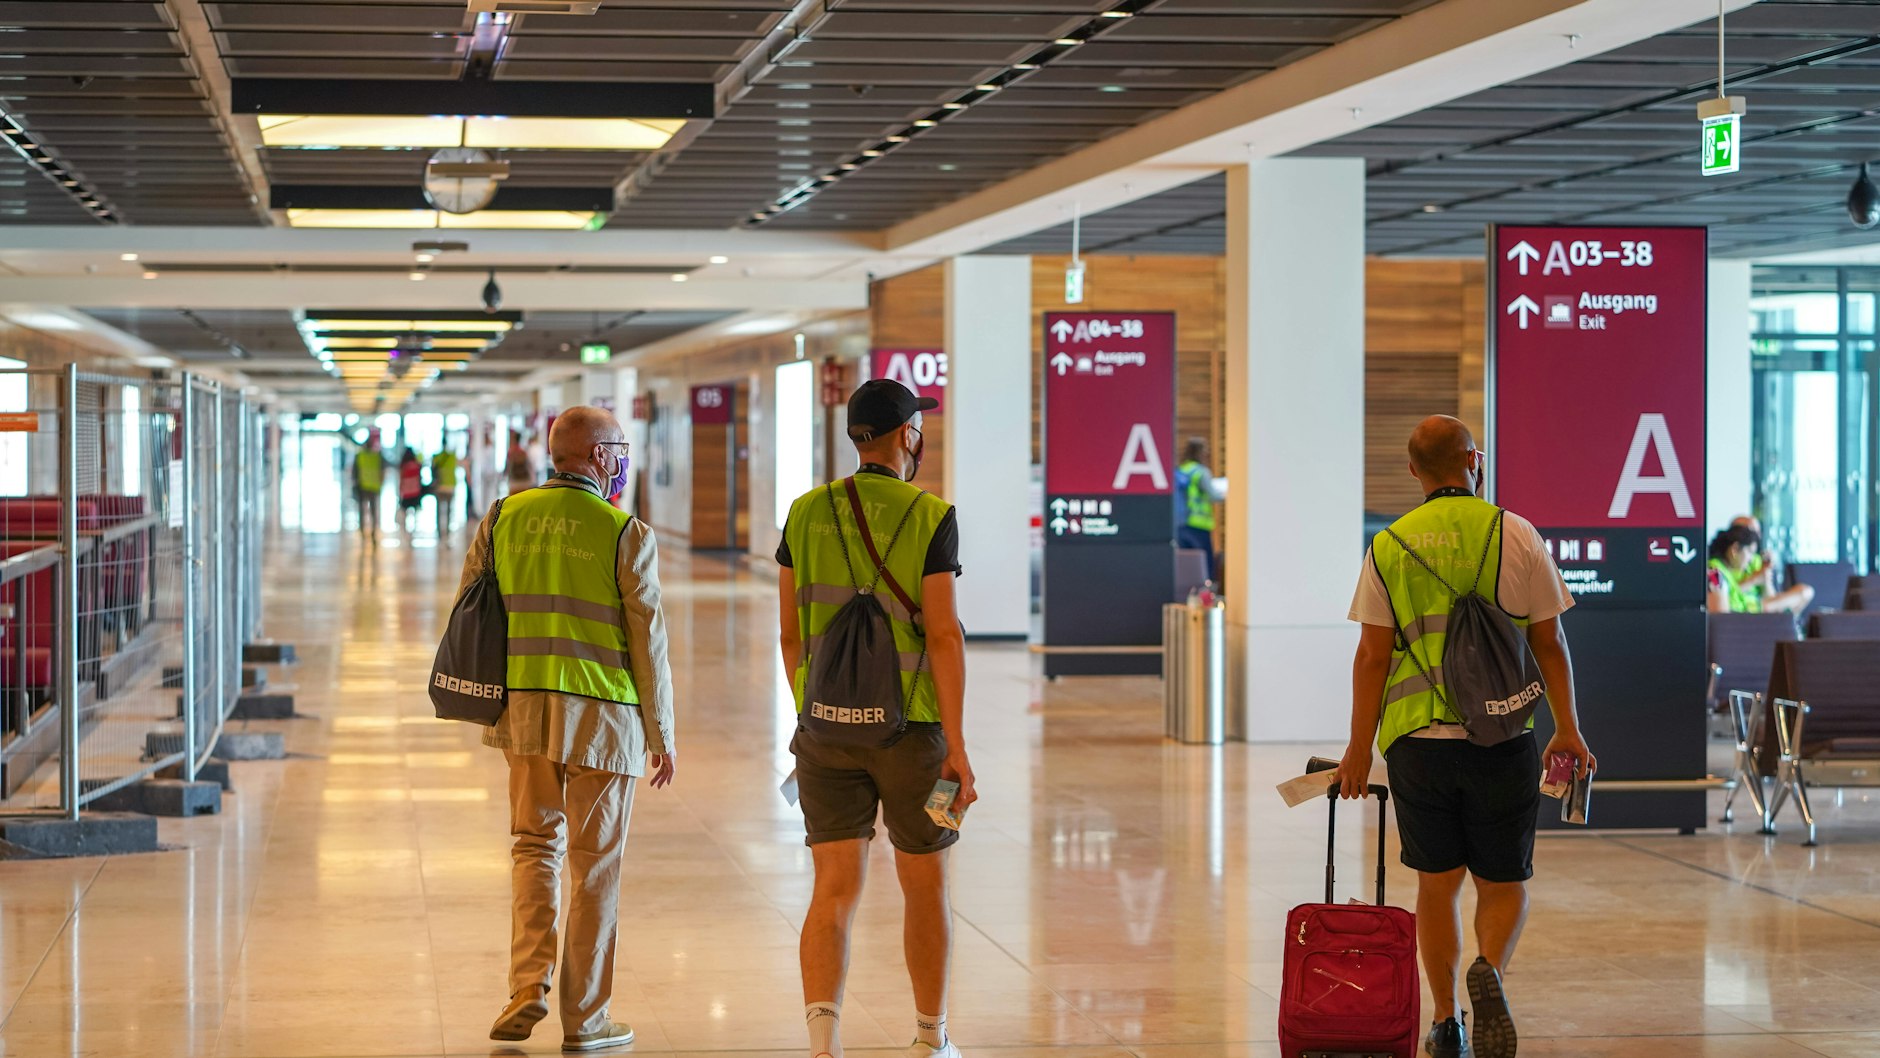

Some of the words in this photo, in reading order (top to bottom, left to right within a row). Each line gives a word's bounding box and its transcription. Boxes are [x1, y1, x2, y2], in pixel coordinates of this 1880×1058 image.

[1542, 240, 1654, 276] A03–38
[1578, 291, 1658, 315] Ausgang
[1578, 314, 1607, 330] Exit
[1112, 423, 1169, 490] A
[1607, 412, 1697, 519] A
[525, 516, 581, 537] ORAT
[473, 682, 504, 700] BER
[1519, 681, 1544, 706] BER
[851, 707, 886, 724] BER
